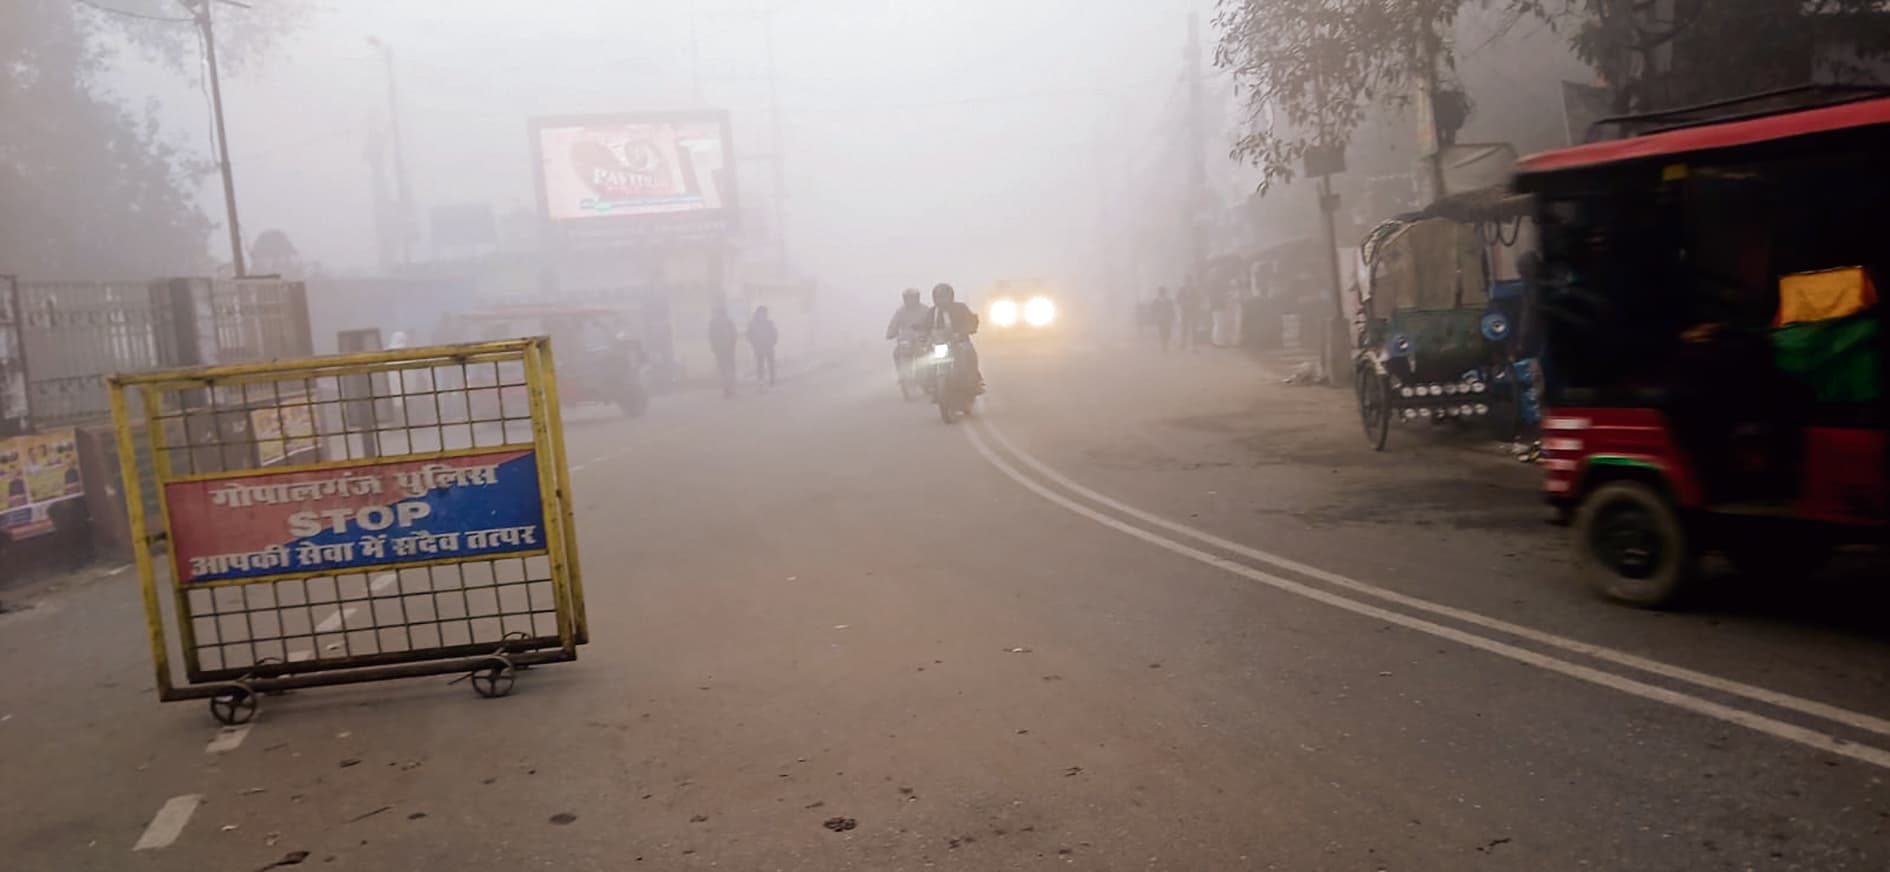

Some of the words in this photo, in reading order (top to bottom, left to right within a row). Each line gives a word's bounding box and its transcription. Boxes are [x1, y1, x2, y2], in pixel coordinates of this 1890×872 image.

[209, 472, 380, 508] गोपालगंज
[393, 464, 499, 497] पुलिस
[289, 502, 431, 538] STOP
[190, 545, 289, 577] आपकी
[298, 541, 352, 566] सेवा
[360, 533, 388, 557] में
[465, 525, 536, 547] तत्पर
